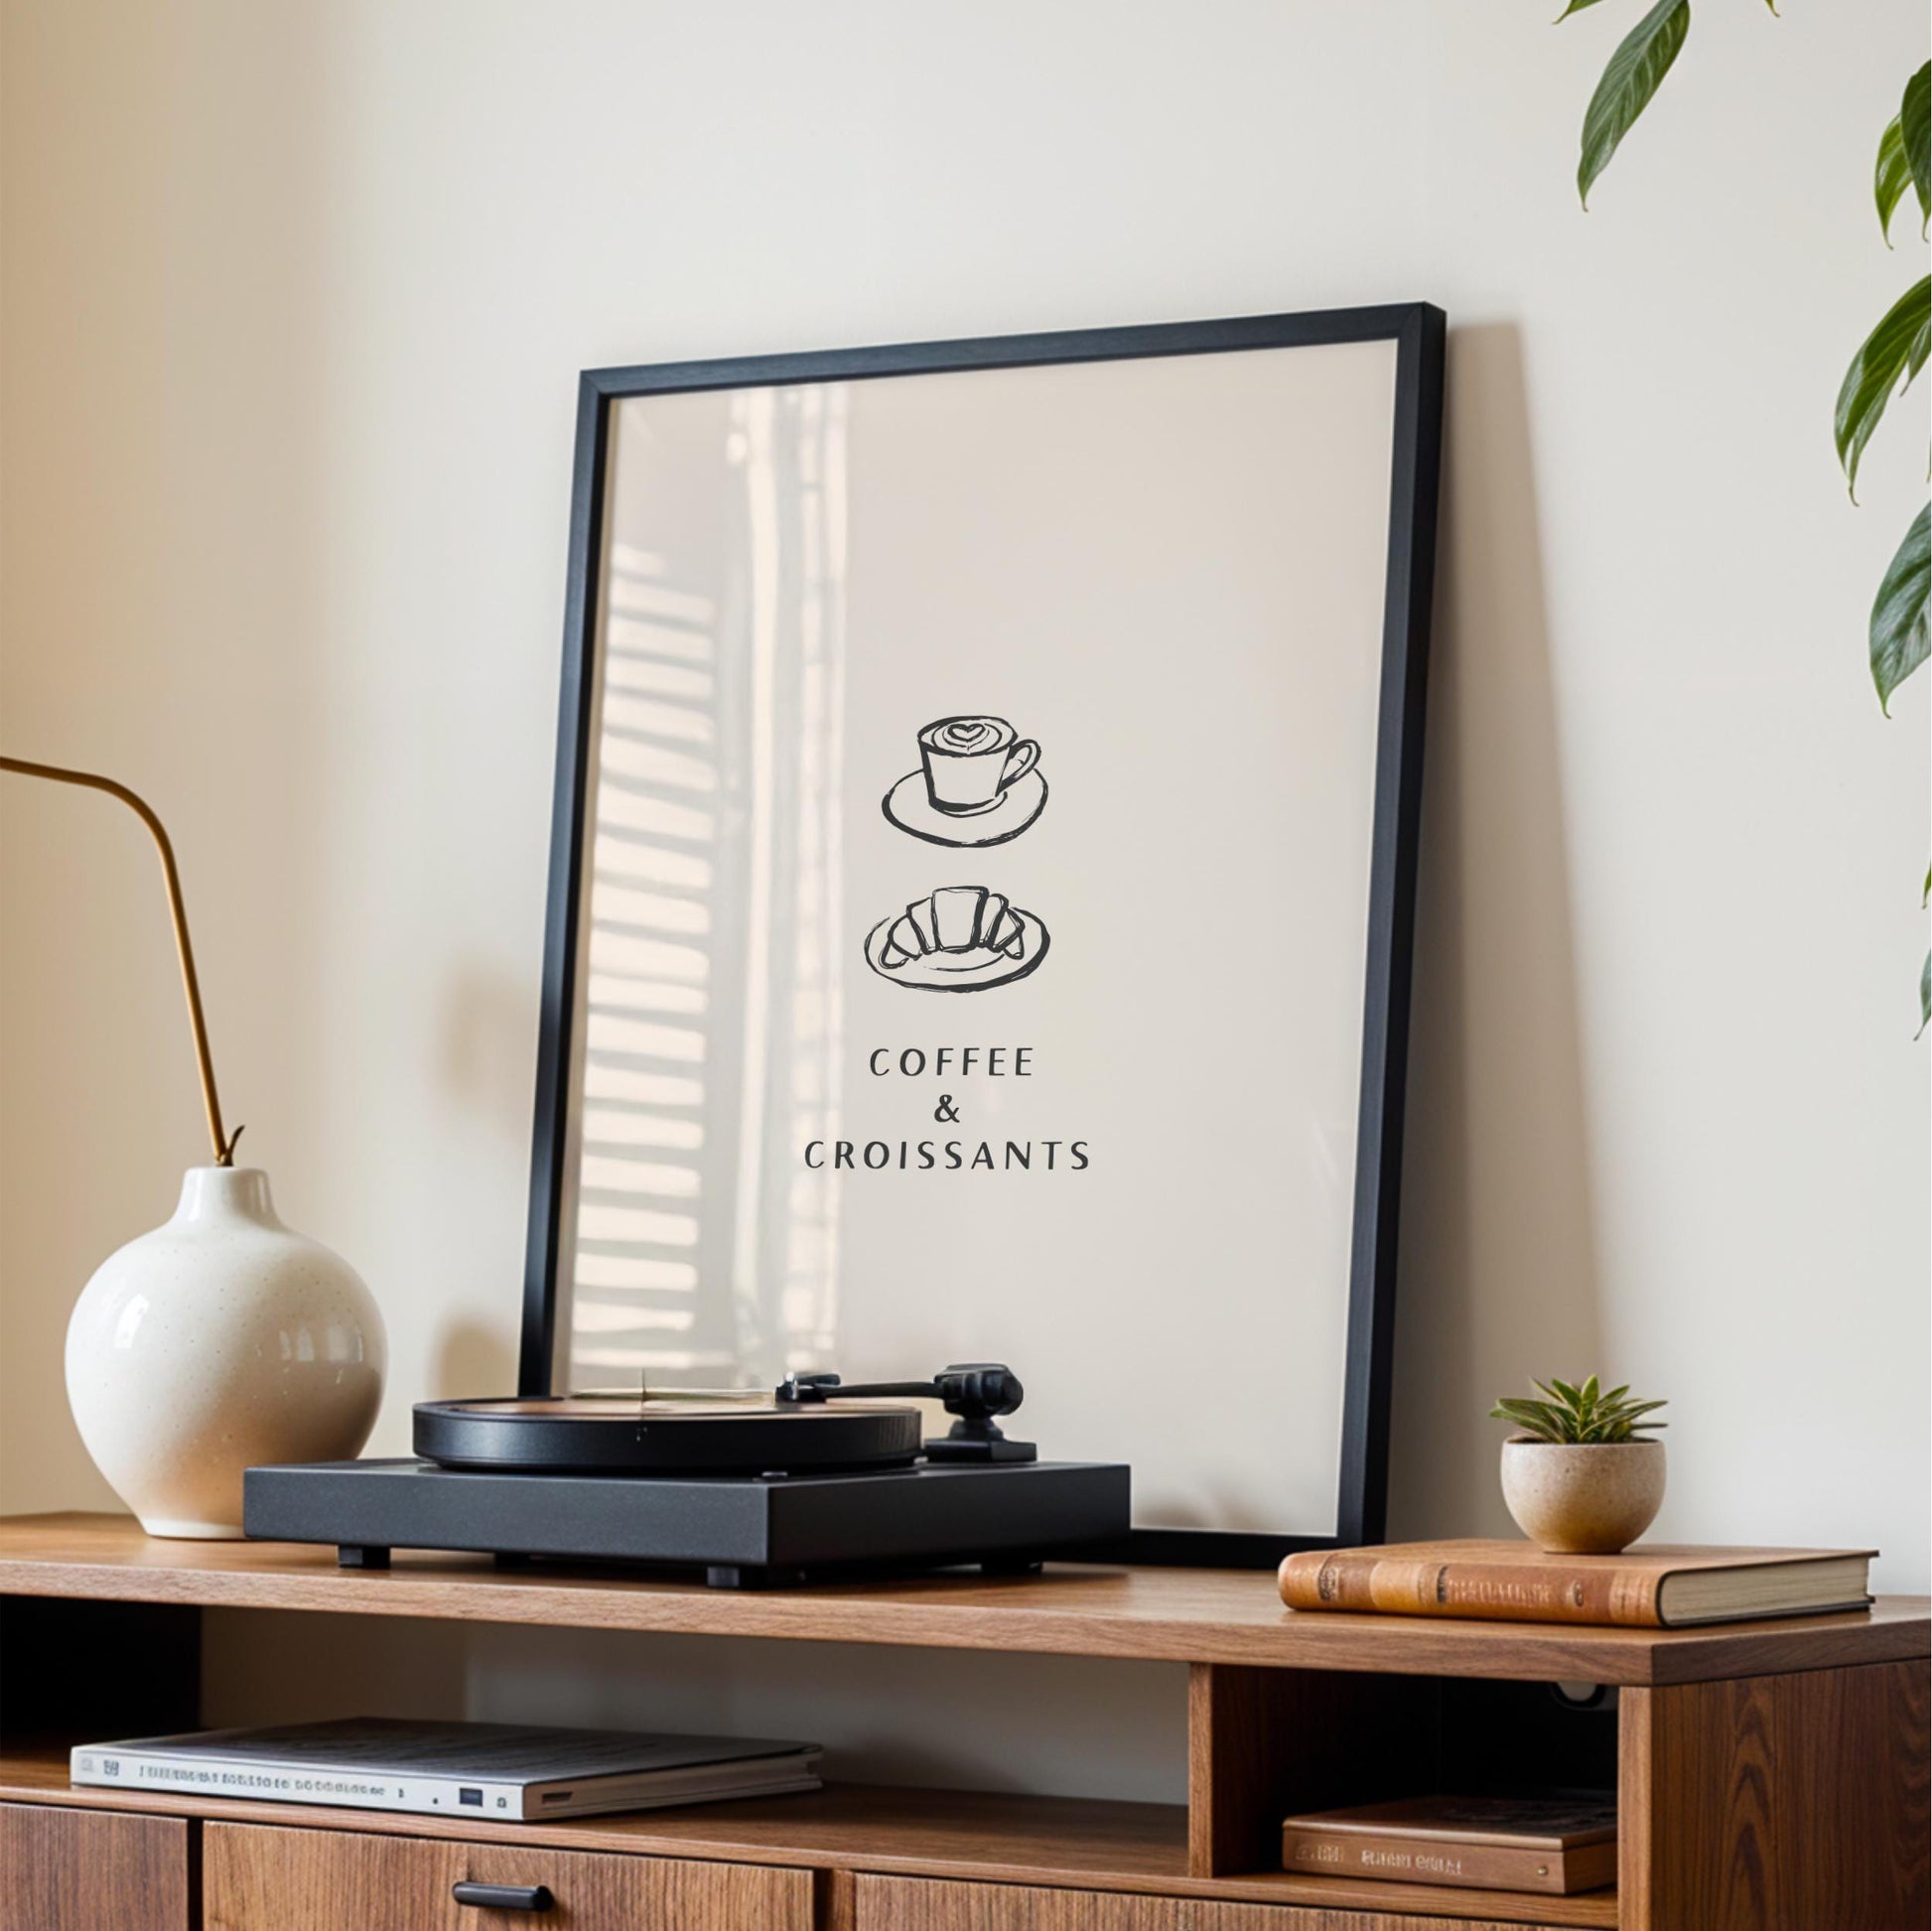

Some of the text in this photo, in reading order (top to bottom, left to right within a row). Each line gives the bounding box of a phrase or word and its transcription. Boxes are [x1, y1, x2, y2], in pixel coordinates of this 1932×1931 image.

[870, 1047, 1034, 1076] COFFEE
[933, 1094, 960, 1123] &
[804, 1141, 1089, 1171] CROISSANTS
